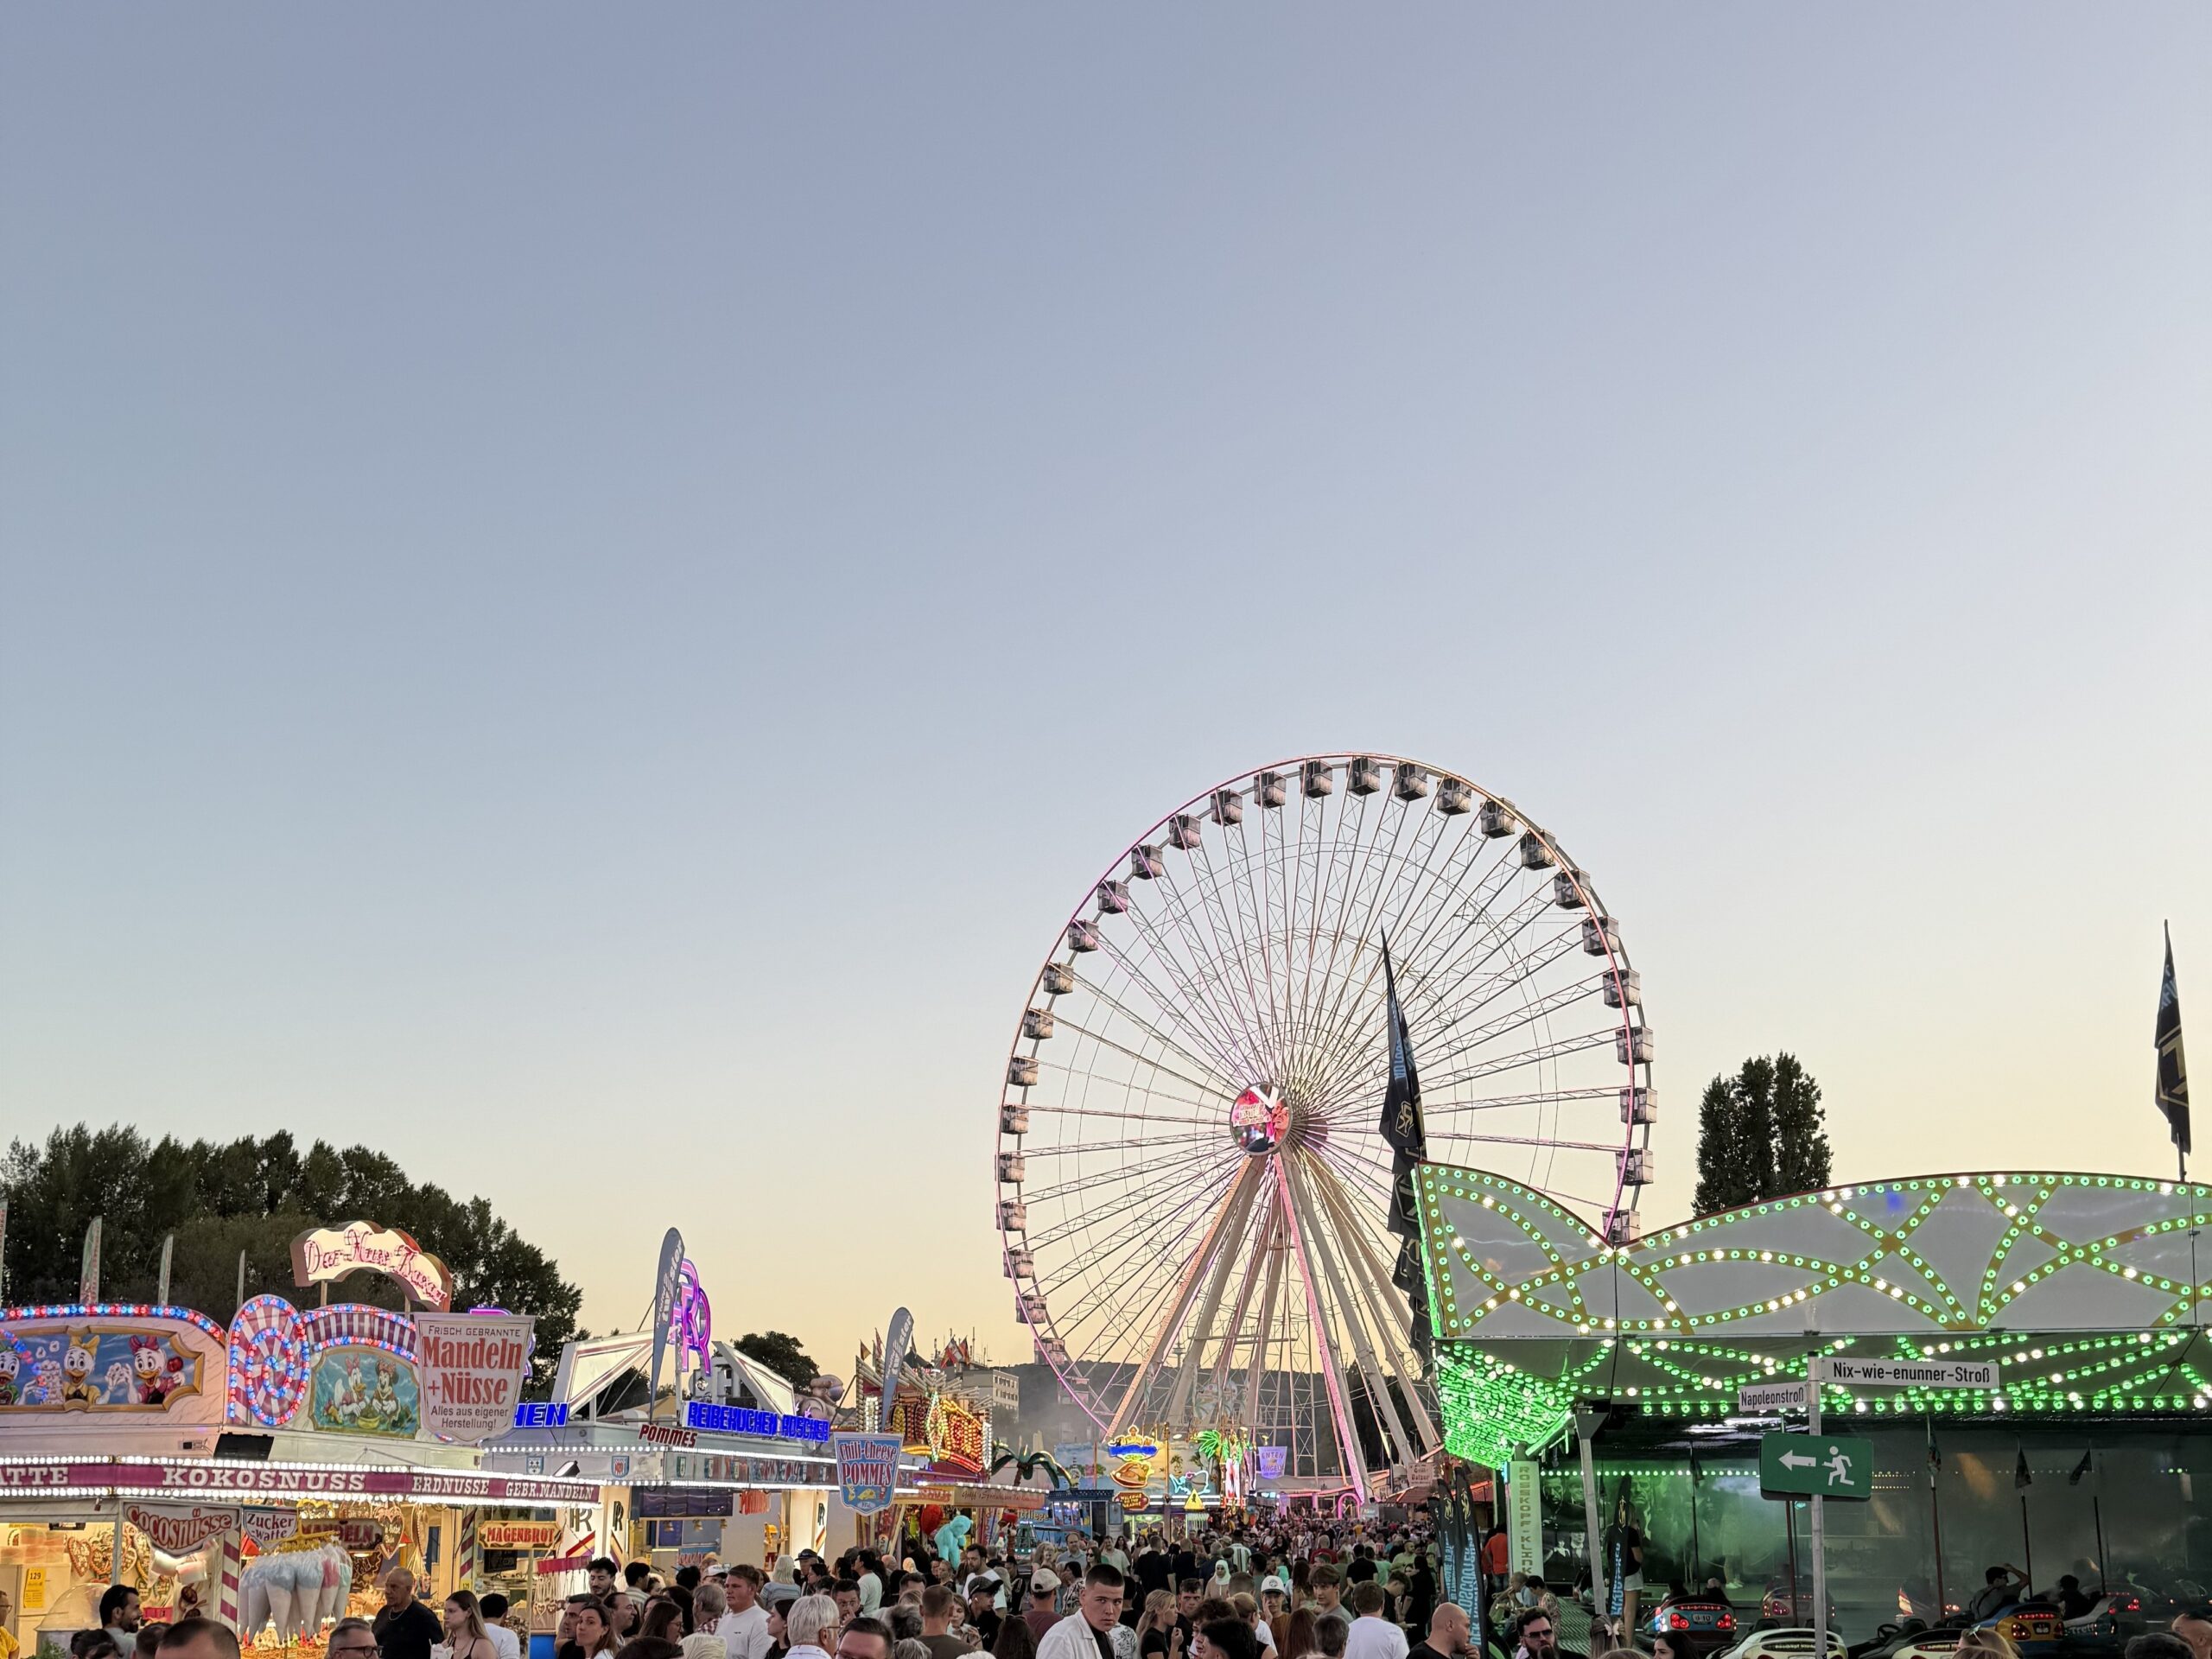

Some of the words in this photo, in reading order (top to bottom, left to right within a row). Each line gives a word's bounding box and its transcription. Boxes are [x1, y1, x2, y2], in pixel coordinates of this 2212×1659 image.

[466, 1328, 521, 1338] GEBRANNTE
[422, 1336, 523, 1370] Mandeln
[1834, 1362, 1990, 1382] Nix-wie-enunner-Stroß
[428, 1371, 508, 1406] +Nüsse
[1741, 1387, 1804, 1408] Napoleonstroß
[431, 1406, 454, 1416] Alles
[475, 1408, 508, 1419] eigener
[442, 1418, 497, 1431] Herstellung!
[638, 1424, 697, 1448] POMMES
[839, 1440, 897, 1461] Chili-Cheese
[162, 1467, 365, 1491] KOKOSNUSS
[841, 1462, 894, 1486] POMMES
[126, 1506, 232, 1549] Cocosnüsse
[247, 1513, 294, 1529] Zucker
[486, 1527, 555, 1543] MAGENBROT
